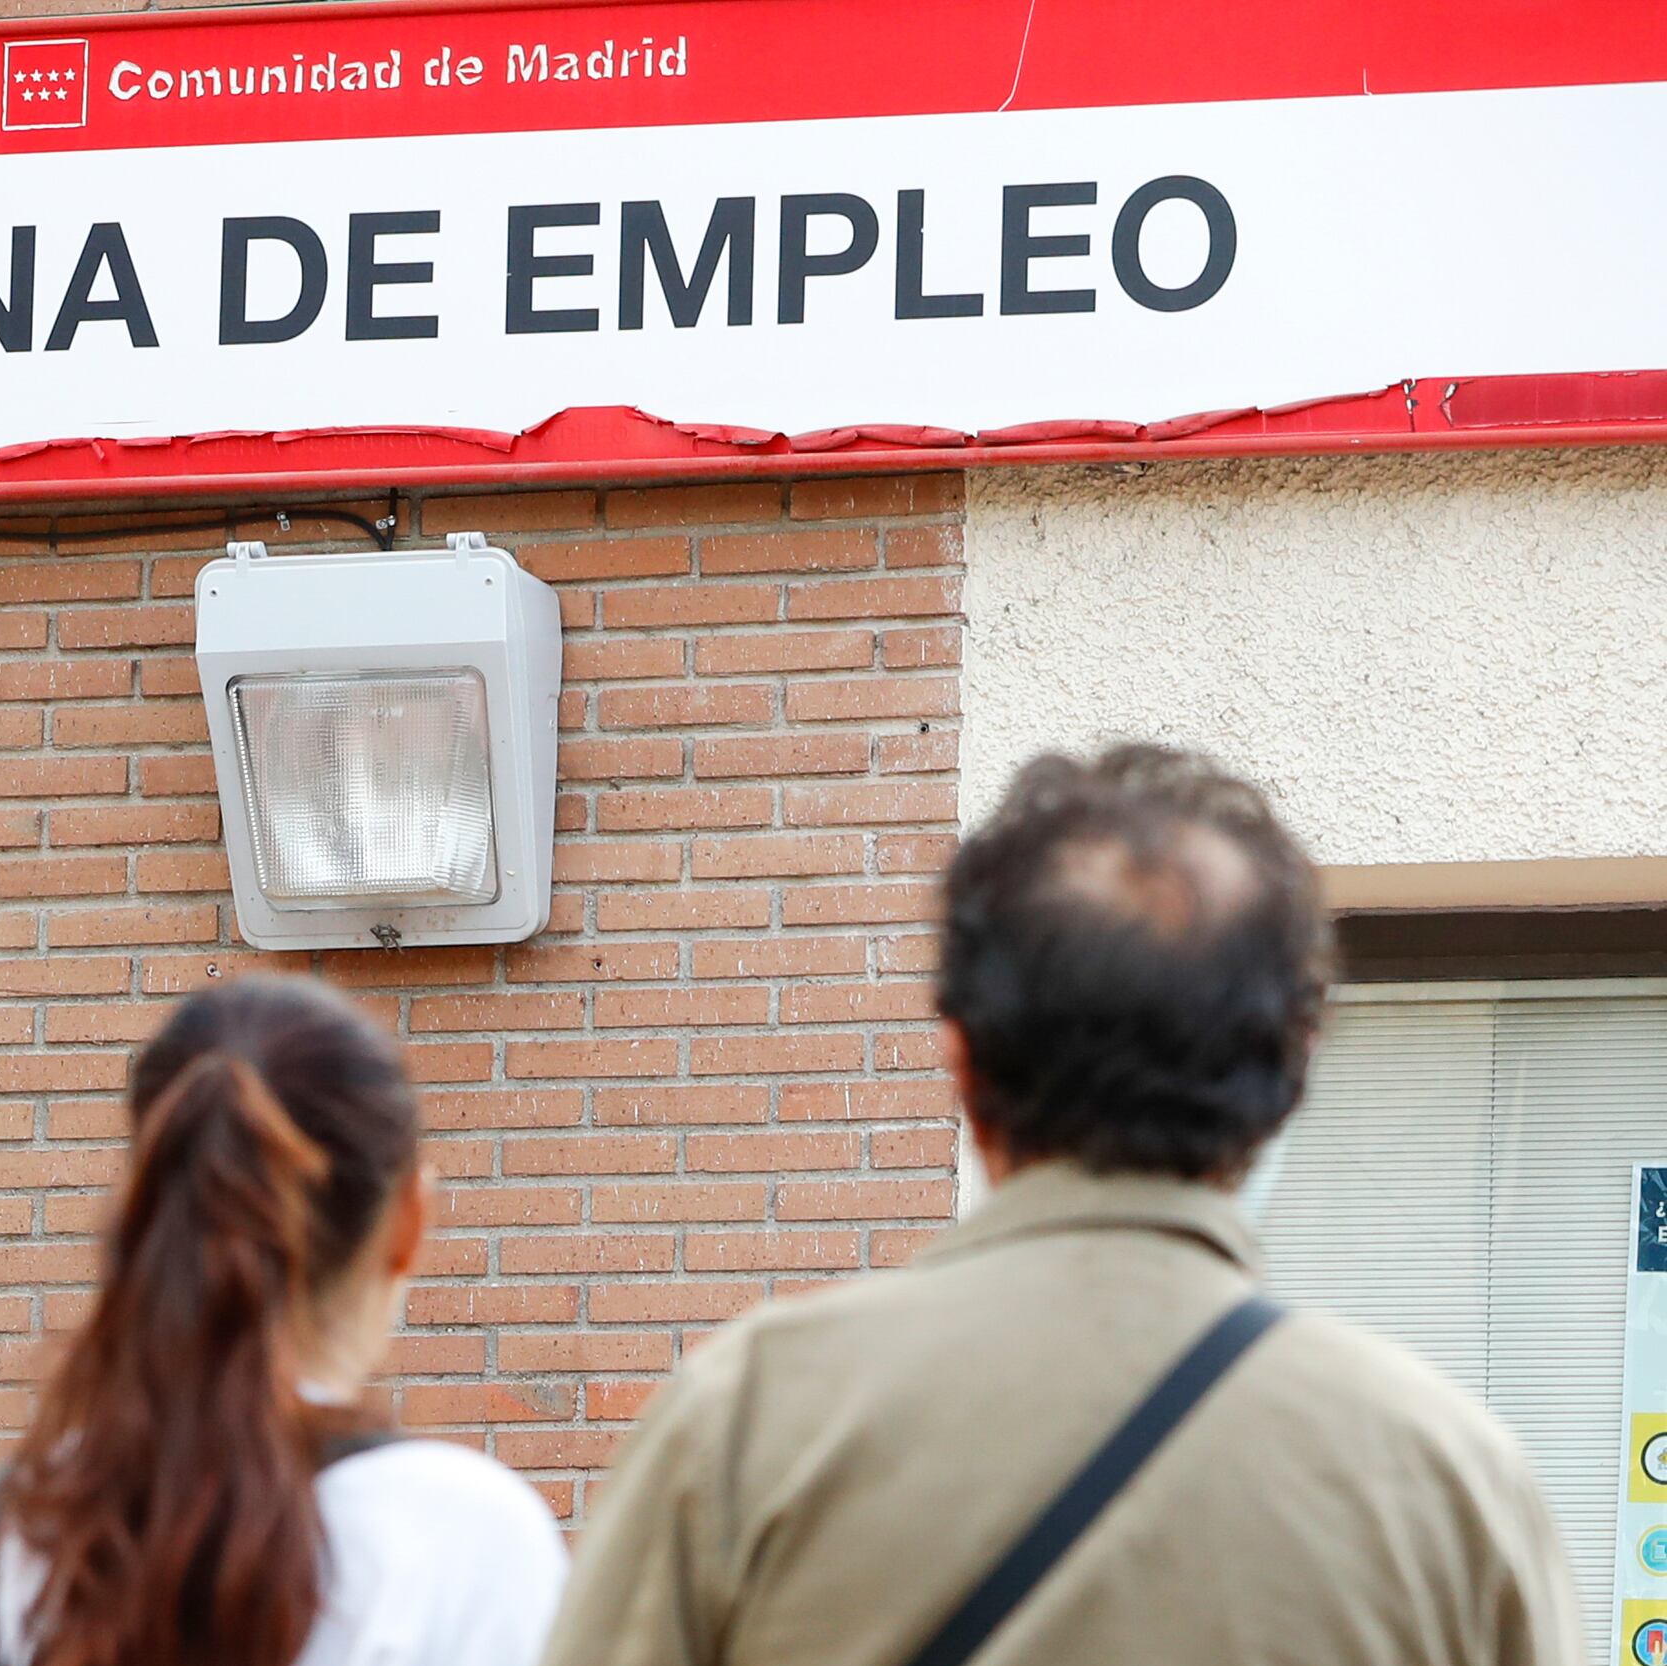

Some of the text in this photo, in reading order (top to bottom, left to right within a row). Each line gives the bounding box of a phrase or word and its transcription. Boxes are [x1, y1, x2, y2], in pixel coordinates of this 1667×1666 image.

[108, 35, 688, 100] Comunidad de Madrid
[218, 210, 441, 346] DE
[505, 175, 1237, 335] EMPLEO
